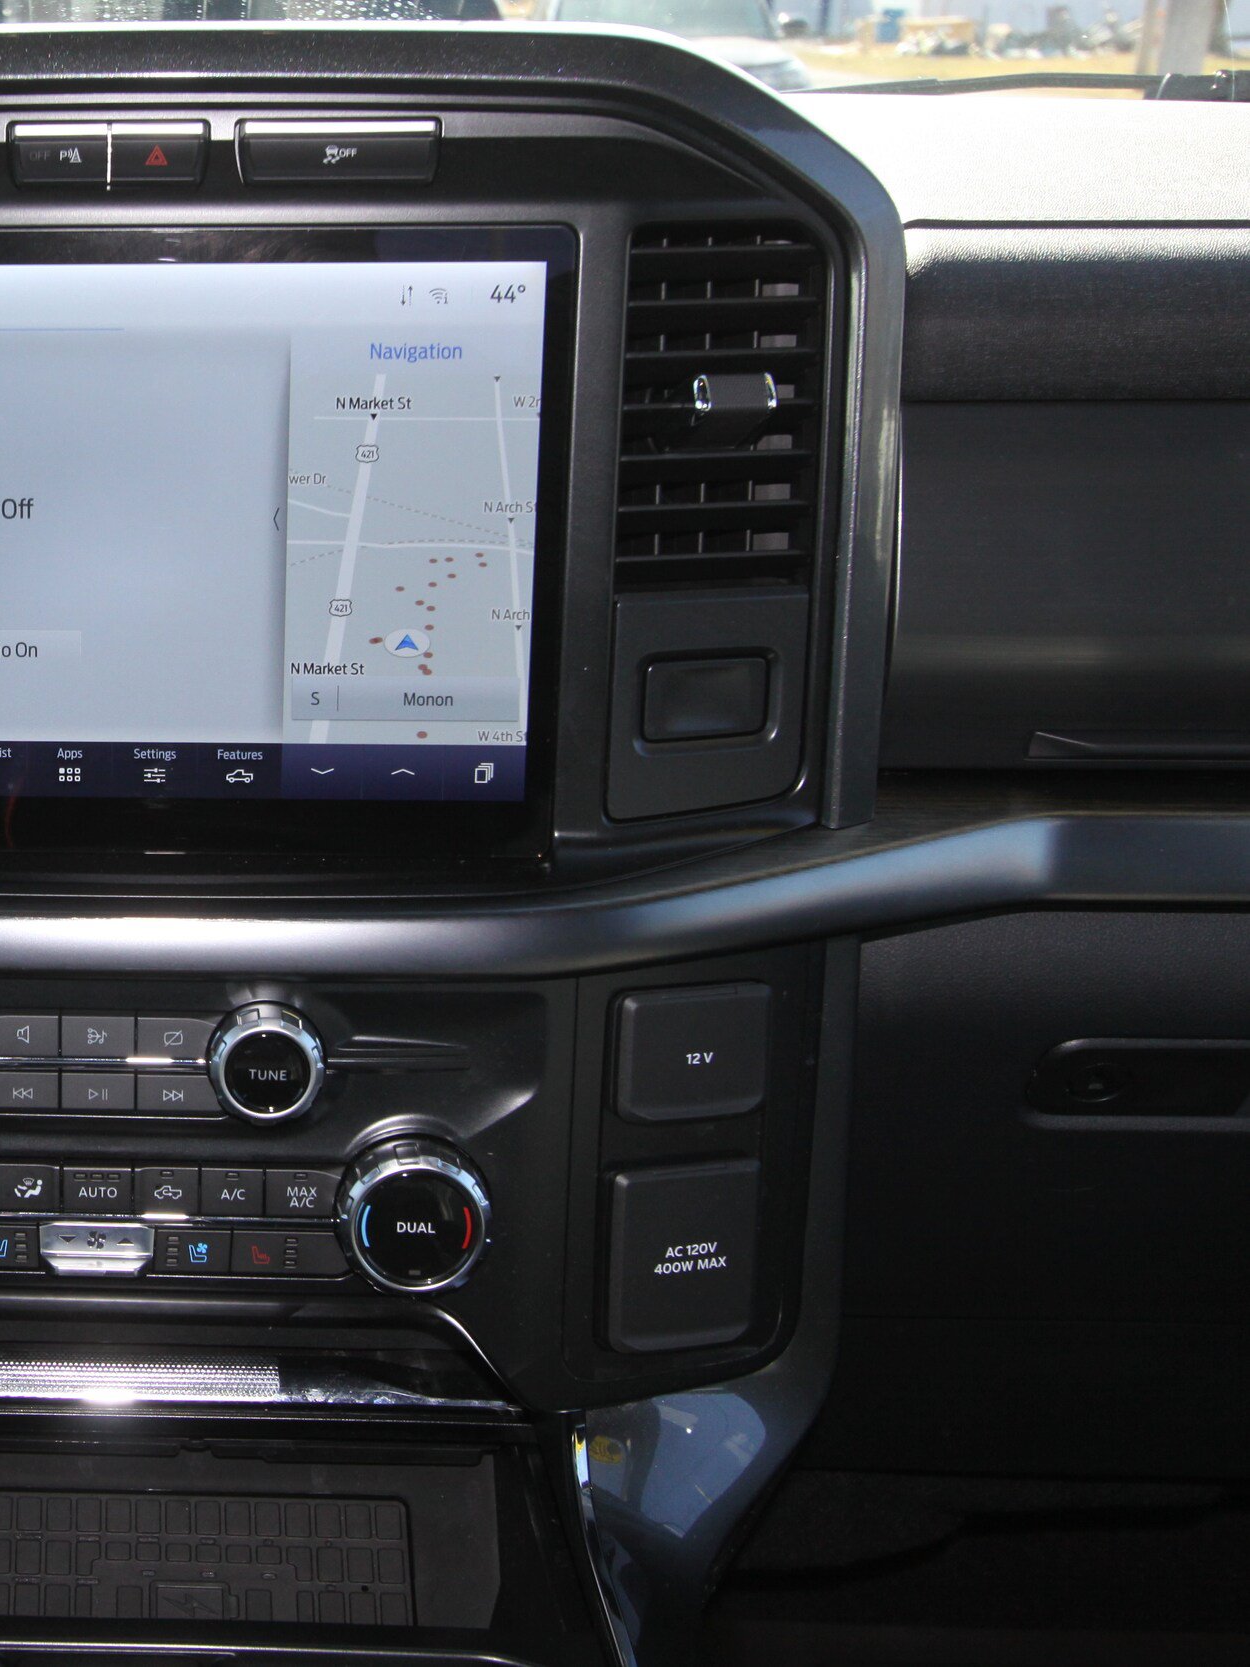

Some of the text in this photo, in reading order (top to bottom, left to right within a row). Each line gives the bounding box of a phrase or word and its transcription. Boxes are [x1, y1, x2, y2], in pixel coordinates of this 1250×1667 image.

[339, 147, 358, 158] OFF
[490, 284, 526, 304] 44°
[370, 343, 463, 363] Navigation
[336, 396, 412, 410] N Market St
[513, 396, 526, 408] W
[360, 449, 375, 459] 421
[313, 473, 327, 485] Dr
[1, 498, 34, 519] Off
[483, 501, 493, 513] N
[496, 501, 523, 513] Arch
[334, 603, 348, 613] 421
[491, 608, 530, 620] N Arch
[14, 642, 38, 658] On
[290, 663, 364, 675] N Market St
[310, 692, 320, 706] S
[403, 693, 454, 706] Monon
[478, 730, 489, 742] W
[492, 730, 513, 742] 4th
[57, 747, 83, 761] Apps
[133, 747, 177, 761] Settings
[217, 748, 263, 761] Features
[686, 1052, 714, 1065] 12 V
[249, 1068, 288, 1082] TUNE
[78, 1186, 118, 1199] AUTO
[221, 1189, 246, 1201] A/C
[287, 1187, 317, 1198] MAX
[289, 1197, 315, 1209] A/C
[396, 1221, 436, 1234] DUAL
[665, 1242, 717, 1259] AC 120V
[654, 1257, 727, 1275] 400W MAX
